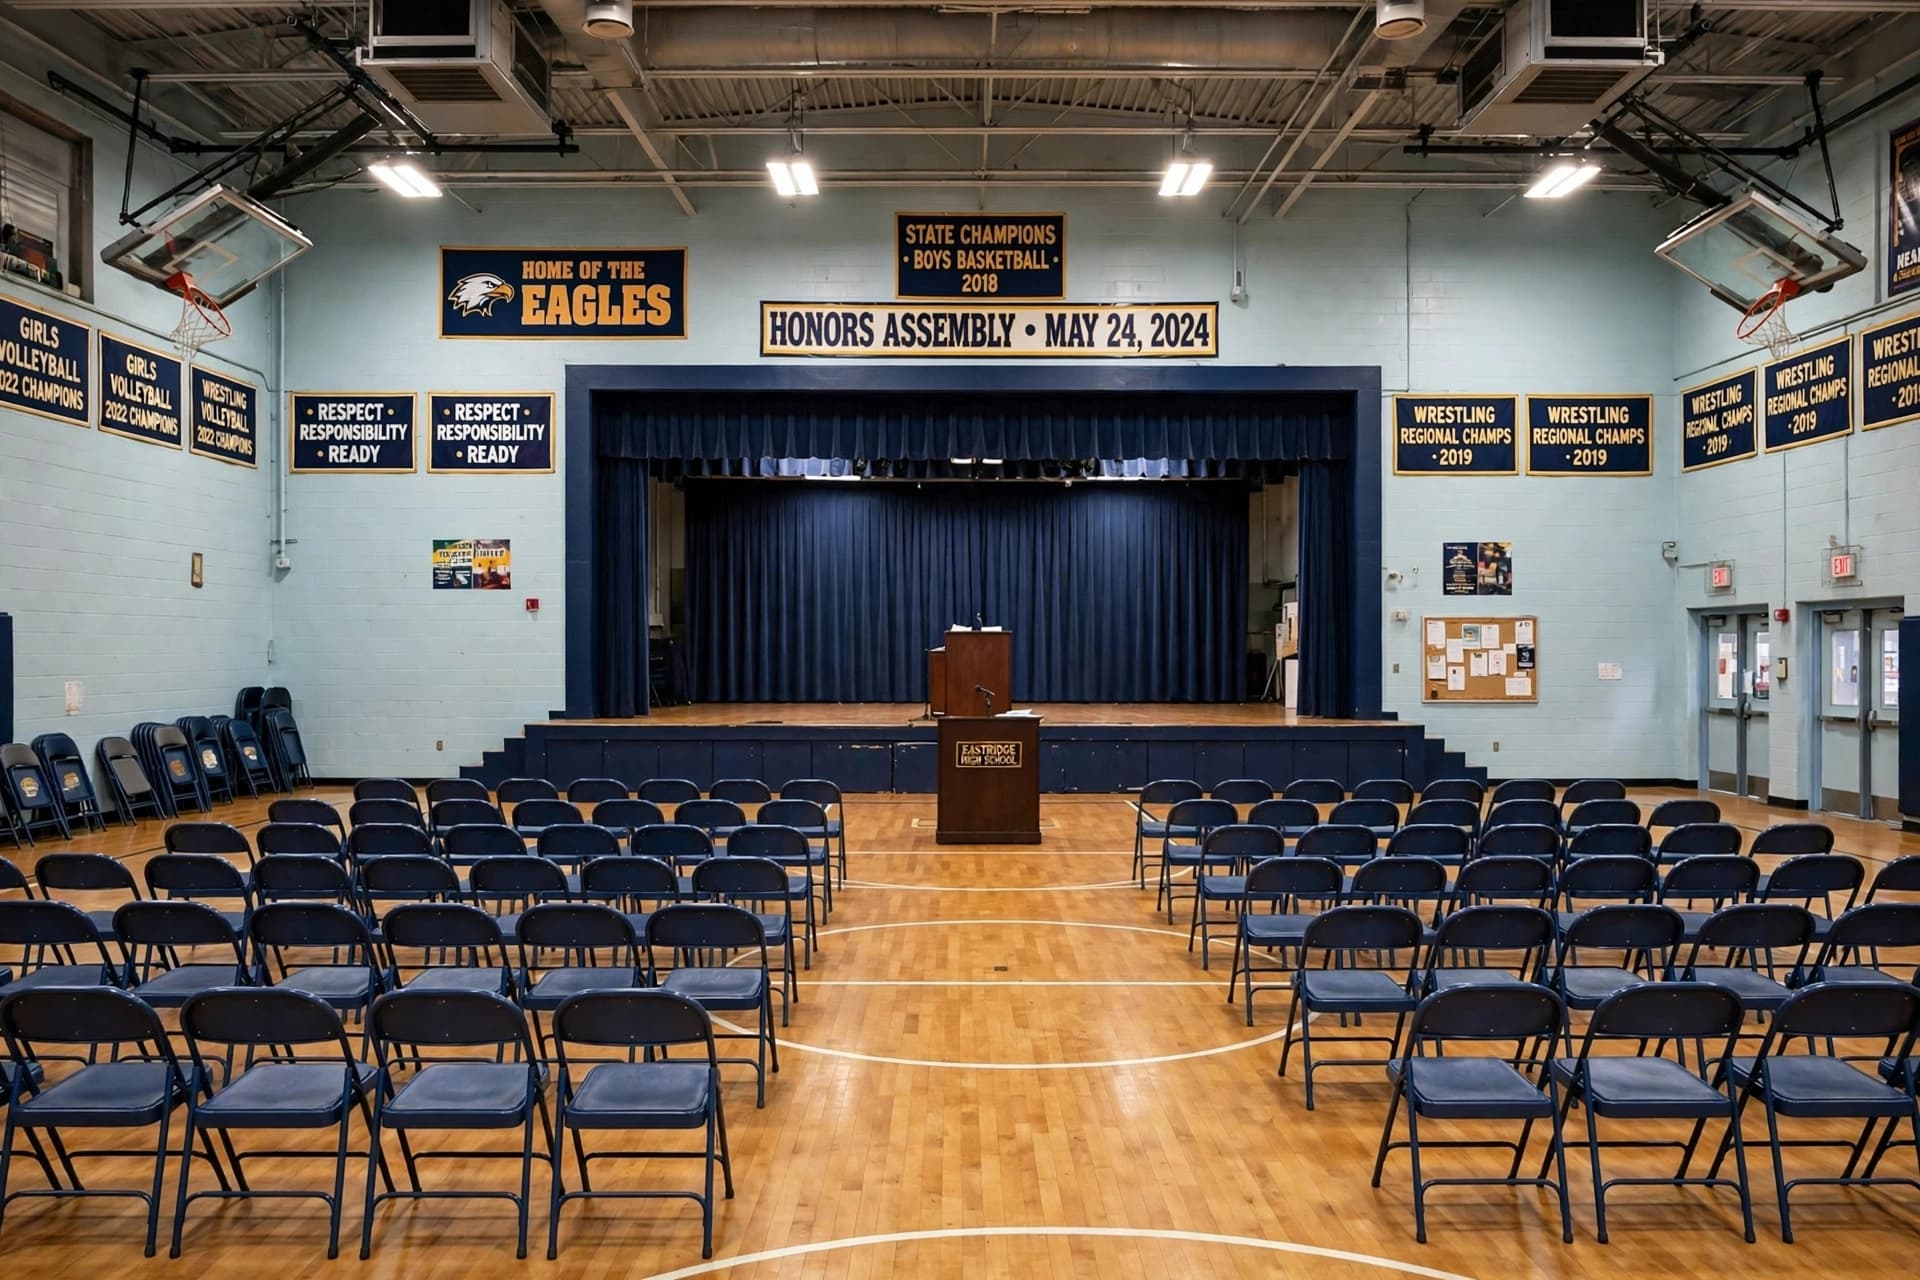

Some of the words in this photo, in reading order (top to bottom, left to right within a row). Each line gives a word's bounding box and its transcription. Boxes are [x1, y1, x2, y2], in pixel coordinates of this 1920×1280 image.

[905, 224, 955, 245] STATE
[959, 224, 1056, 245] CHAMPIONS
[521, 260, 574, 280] HOME
[578, 260, 604, 280] OF
[607, 260, 645, 280] THE
[913, 249, 952, 270] BOYS
[957, 249, 1049, 270] BASKETBALL
[961, 273, 999, 294] 2018
[521, 283, 672, 326] EAGLES
[20, 316, 60, 349] GIRLS
[769, 311, 874, 348] HONORS
[882, 311, 1016, 348] ASSEMBLY
[1045, 312, 1100, 348] MAY
[1105, 312, 1143, 353] 24,
[1149, 312, 1210, 348] 2024
[1873, 326, 1920, 361] WREST
[126, 353, 157, 381] GIRLS
[1776, 354, 1834, 390] WRESTLING
[1867, 355, 1920, 389] REGIONAL
[0, 369, 19, 394] 022
[22, 375, 84, 411] CHAMPIONS
[110, 373, 172, 410] VOLLEYBALL
[202, 378, 247, 410] WRESTLING
[1691, 383, 1742, 416] WRESTLING
[1767, 389, 1809, 417] REGIONAL
[1809, 376, 1847, 406] CHAMPS
[1897, 383, 1920, 409] 201
[105, 401, 128, 422] 2022
[128, 406, 177, 437] CHAMPIONS
[200, 400, 249, 433] VOLLEYBALL
[317, 403, 385, 421] RESPECT
[454, 403, 521, 421] RESPECT
[1413, 406, 1495, 424] WRESTLING
[1547, 406, 1629, 424] WRESTLING
[1721, 403, 1753, 429] CHAMPS
[1792, 410, 1817, 436] 2019
[197, 424, 215, 446] 2022
[299, 423, 407, 441] RESPONSIBILITY
[436, 423, 545, 441] RESPONSIBILITY
[1400, 427, 1459, 445] REGIONAL
[1462, 427, 1512, 445] CHAMPS
[1533, 427, 1592, 445] REGIONAL
[1595, 427, 1645, 445] CHAMPS
[328, 445, 381, 463] READY
[467, 445, 519, 463] READY
[1706, 434, 1728, 456] 2019
[1439, 448, 1473, 466] 2019
[1572, 448, 1608, 466] 2019
[962, 744, 1017, 755] EASTRIDGE
[983, 754, 1017, 765] SCHOOL
